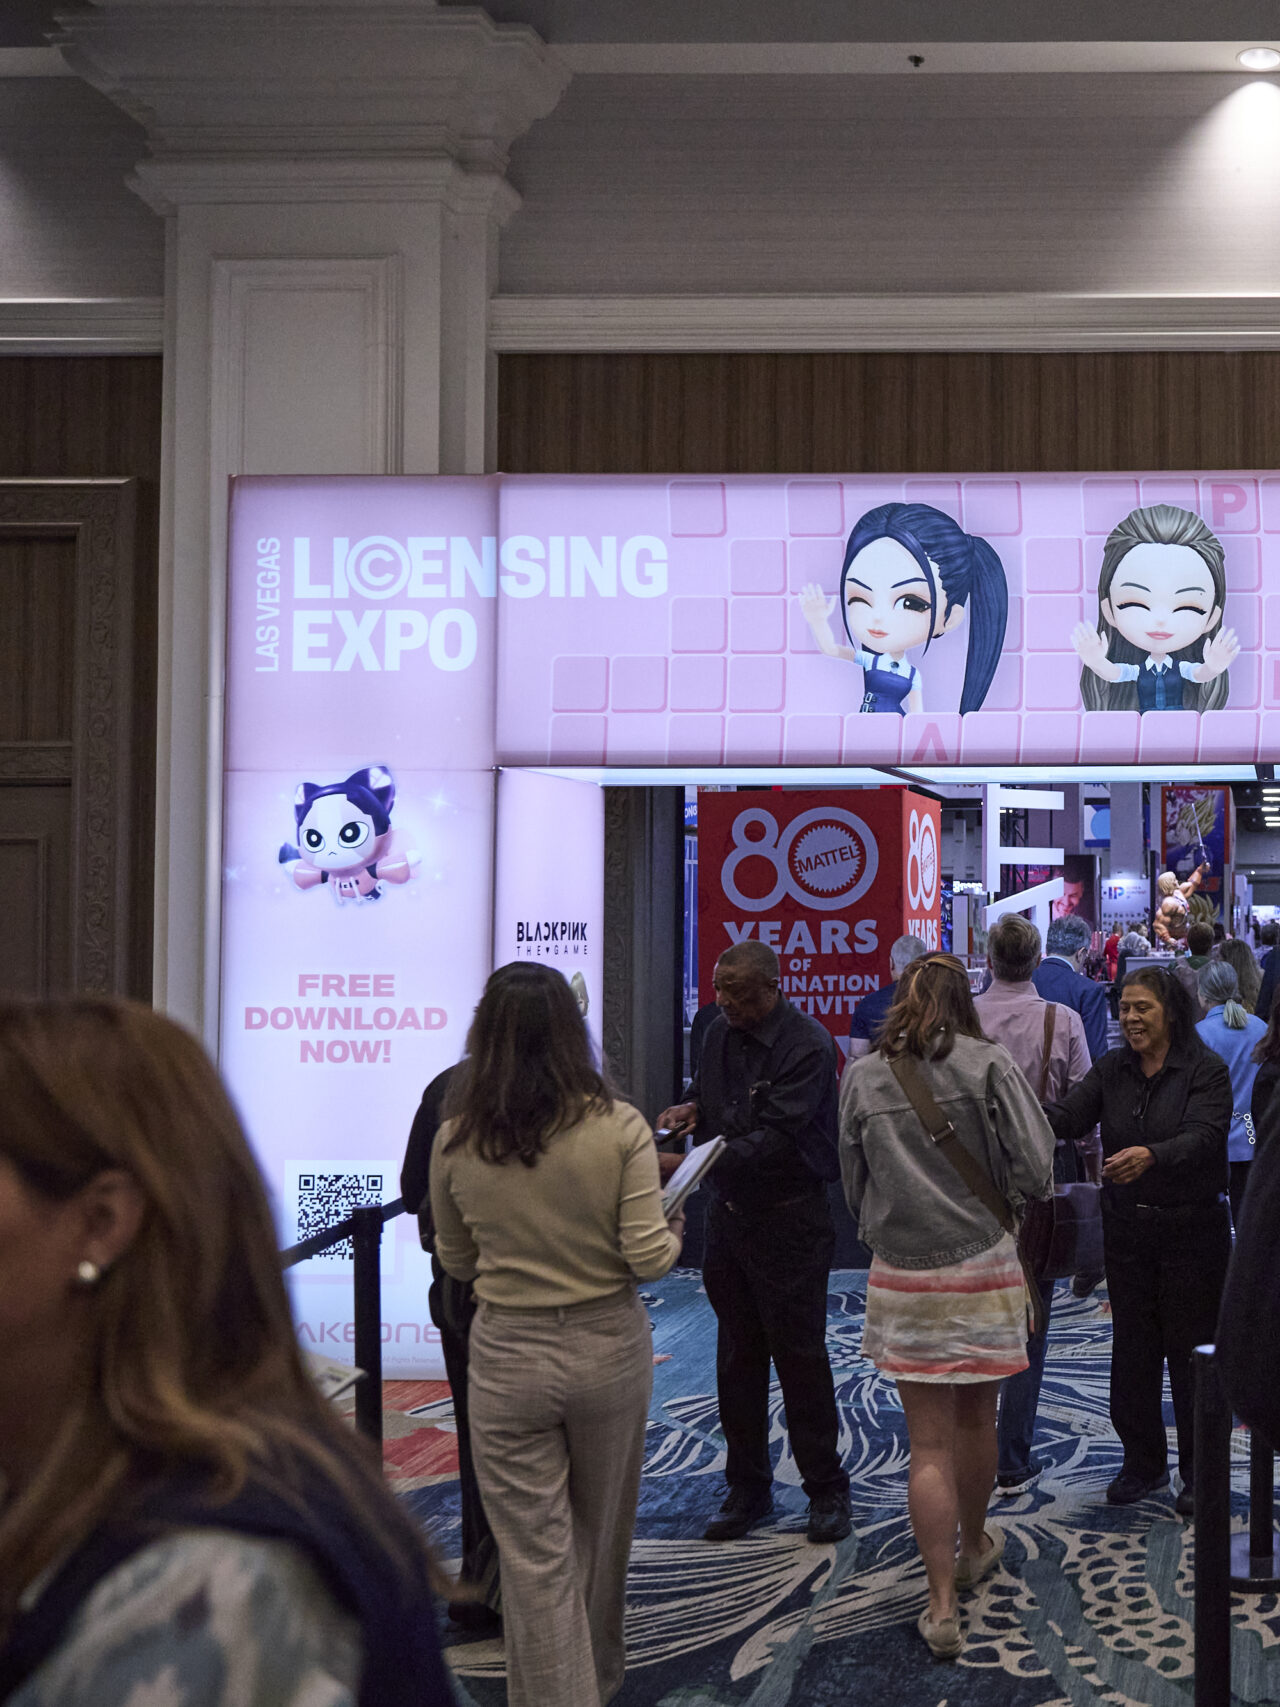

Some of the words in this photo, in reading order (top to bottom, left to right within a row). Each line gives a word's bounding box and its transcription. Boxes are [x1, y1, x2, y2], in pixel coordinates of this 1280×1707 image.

[256, 537, 281, 621] VEGAS
[293, 535, 668, 600] LICENSING
[255, 625, 280, 672] LAS
[292, 608, 478, 672] EXPO
[721, 806, 880, 913] 80
[799, 845, 861, 874] MATTEL
[907, 808, 938, 912] 80
[517, 945, 541, 957] THE
[554, 944, 588, 956] GAME
[723, 918, 879, 956] YEARS
[789, 958, 812, 972] OF
[297, 974, 396, 998] FREE
[778, 974, 880, 993] INATION
[244, 1006, 449, 1032] DOWNLOAD
[789, 995, 866, 1015] TIVIT
[299, 1039, 392, 1064] NOW!
